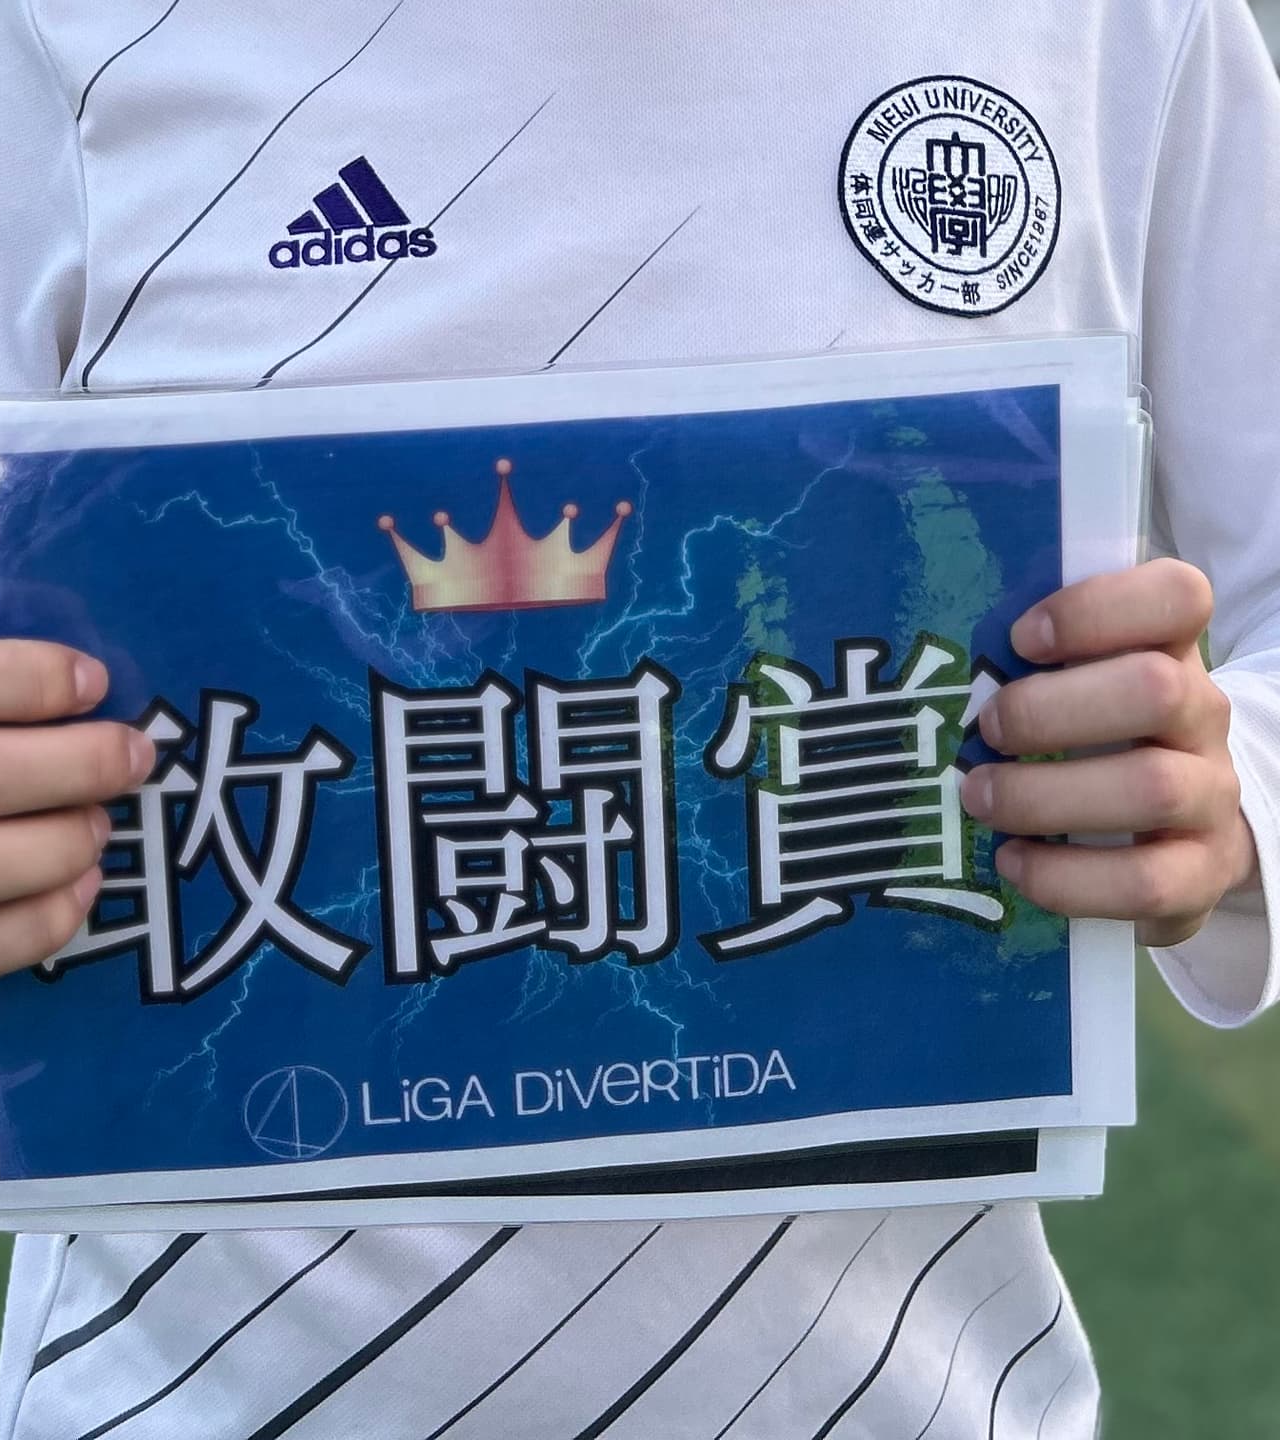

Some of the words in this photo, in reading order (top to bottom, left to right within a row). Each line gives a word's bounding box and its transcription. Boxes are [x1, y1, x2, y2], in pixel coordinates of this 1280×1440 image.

[867, 93, 921, 144] MEIJI
[924, 86, 1044, 163] UNIVERSITY
[268, 224, 438, 269] adidas
[41, 643, 1007, 994] 敢闘賞
